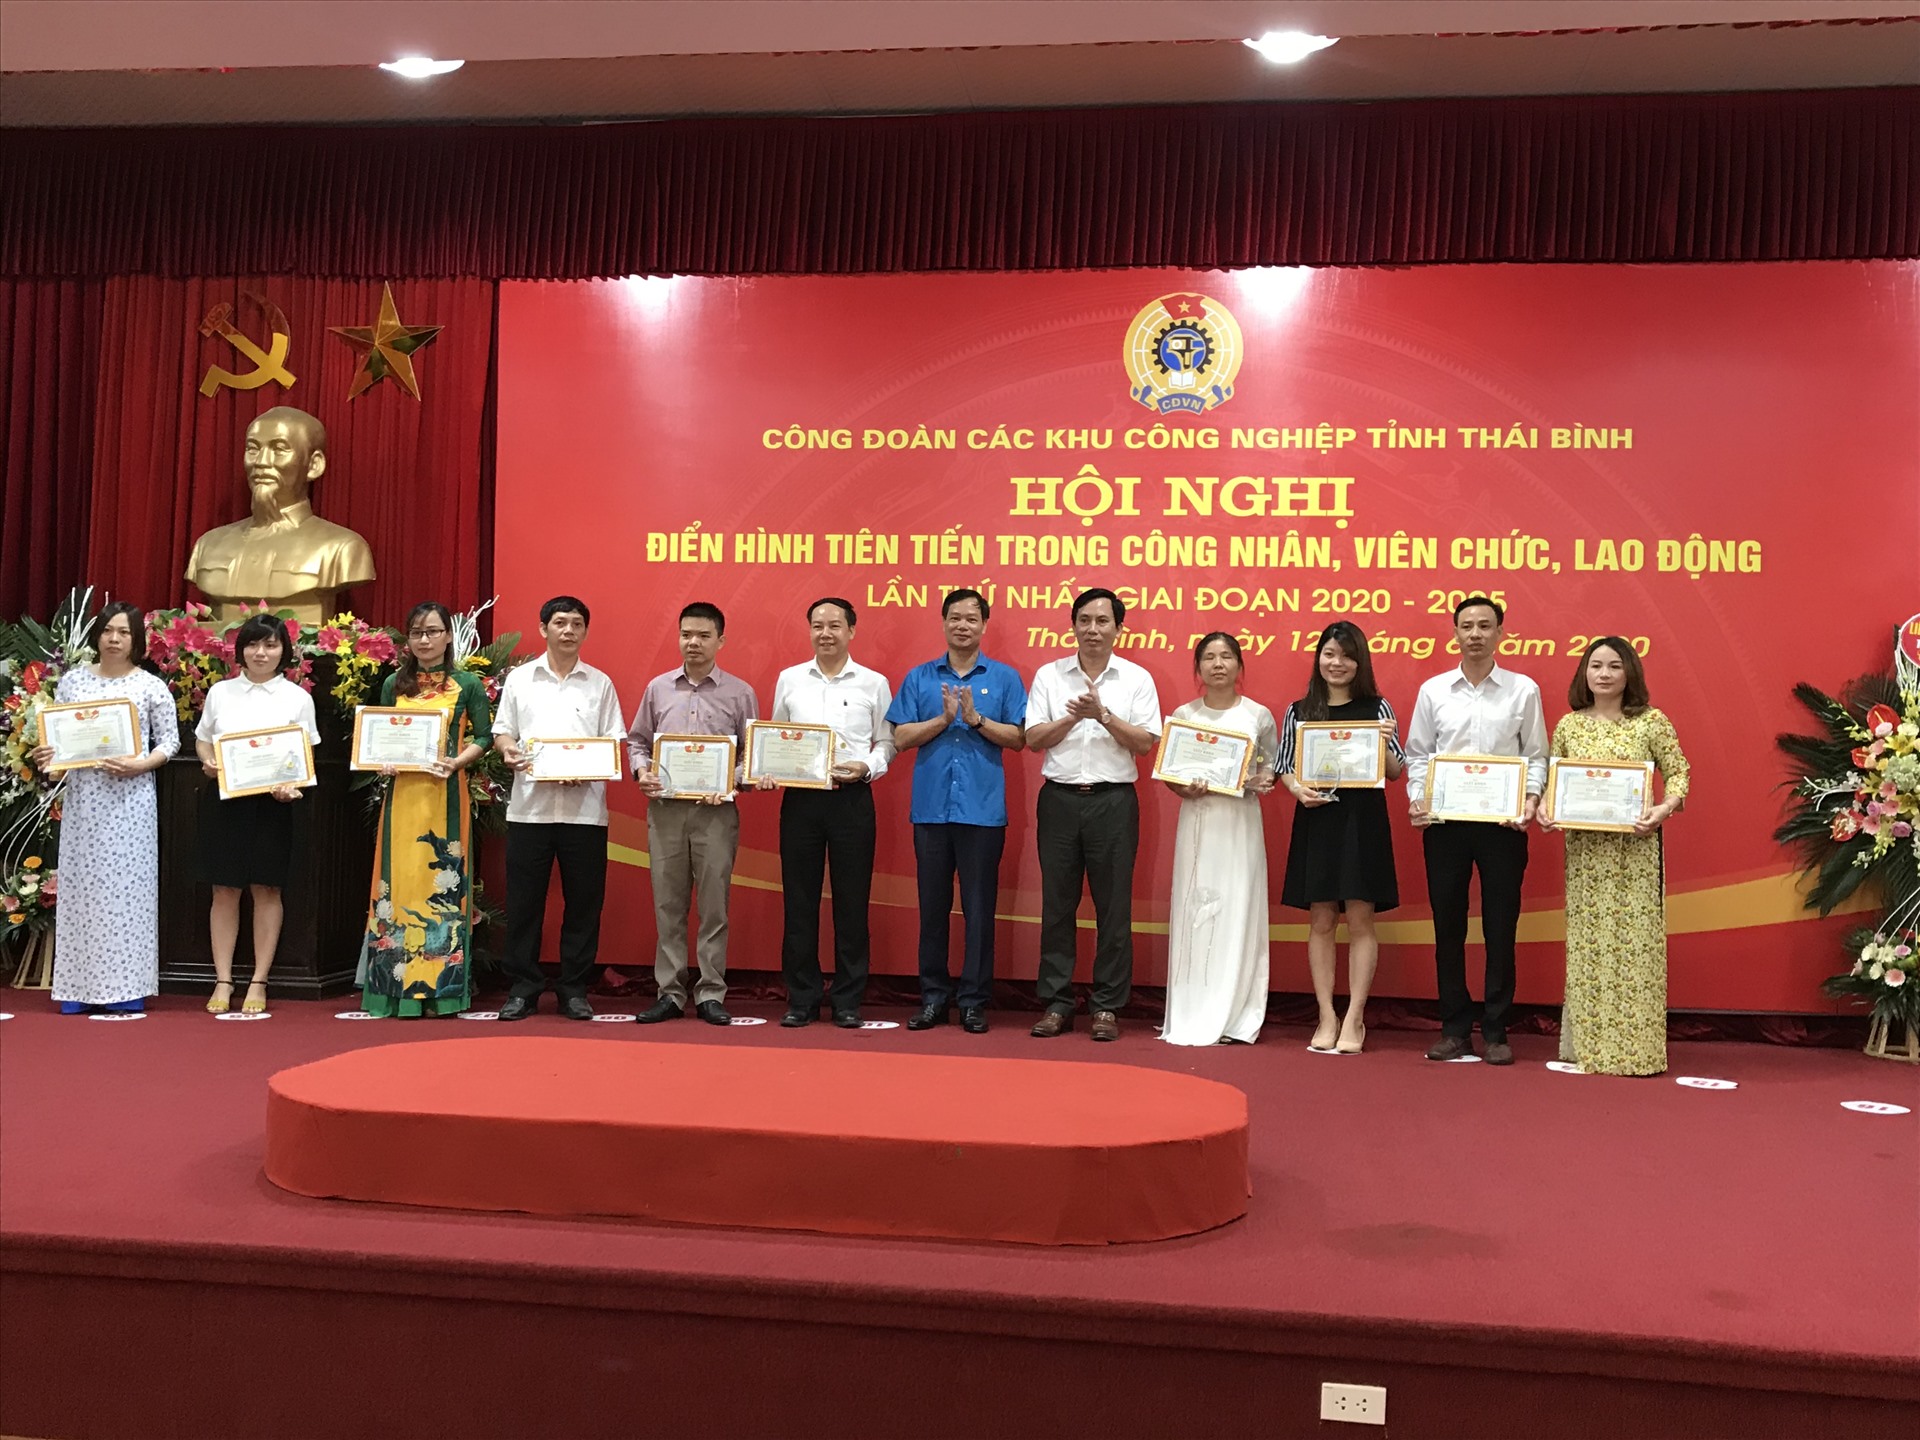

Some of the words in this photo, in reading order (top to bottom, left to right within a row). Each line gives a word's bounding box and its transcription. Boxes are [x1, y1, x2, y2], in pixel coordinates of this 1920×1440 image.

[762, 423, 852, 450] CÔNG
[861, 423, 957, 450] ĐOÀN
[966, 423, 1035, 450] CÁC
[1045, 428, 1113, 450] KHU
[1123, 422, 1220, 449] CÔNG
[1231, 422, 1357, 455] NGHIỆP
[1366, 419, 1447, 449] TỈNH
[1457, 422, 1539, 449] THÁI
[1550, 422, 1633, 449] BÌNH
[1009, 463, 1142, 527] HỘI
[1162, 475, 1356, 530] NGHỊ
[645, 520, 724, 563] ĐIỂN
[734, 526, 814, 564] HÌNH
[824, 527, 899, 565] TIÊN
[909, 523, 985, 566] TIẾN
[995, 534, 1110, 567] TRONG
[1120, 528, 1218, 568] CÔNG
[1229, 529, 1342, 573] NHÂN,
[1353, 530, 1438, 569] VIÊN
[1450, 528, 1562, 575] CHỨC,
[1574, 538, 1645, 572] LAO
[1656, 533, 1762, 580] ĐỘNG
[867, 575, 928, 608] LẦN
[937, 577, 997, 607] TỨ
[1113, 586, 1183, 611] GIAI
[1194, 587, 1300, 618] ĐOẠN
[1311, 588, 1391, 614] 2020
[1112, 625, 1175, 653] ình,
[1187, 627, 1276, 656] này
[1291, 630, 1324, 652] 12
[1493, 632, 1557, 656] ăm
